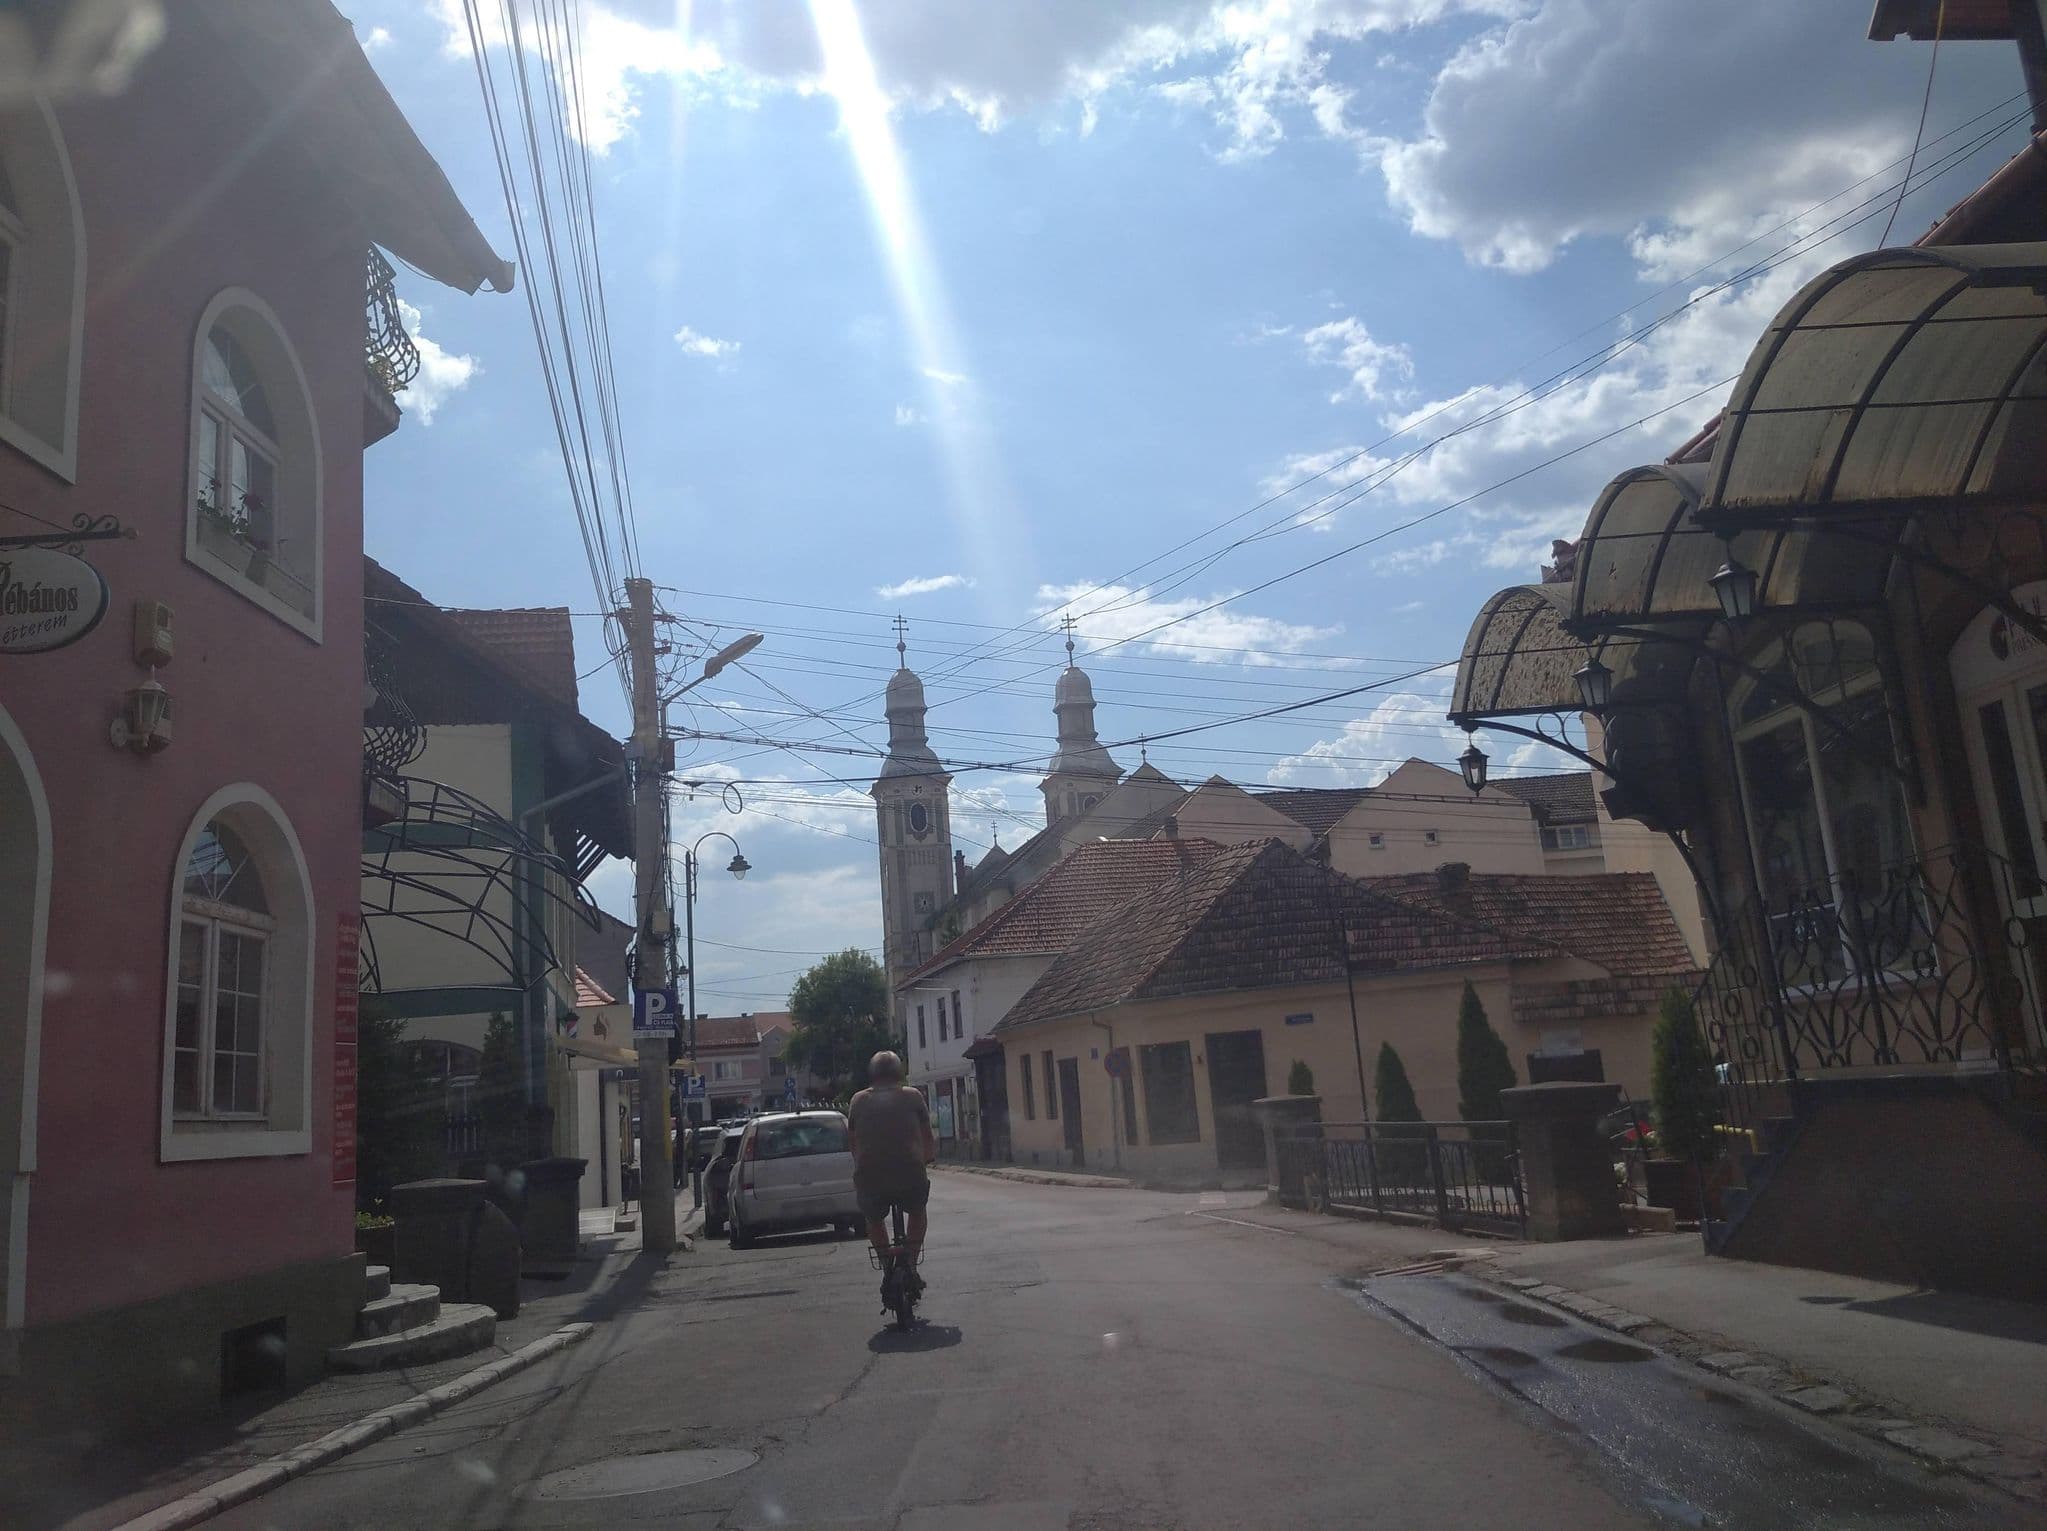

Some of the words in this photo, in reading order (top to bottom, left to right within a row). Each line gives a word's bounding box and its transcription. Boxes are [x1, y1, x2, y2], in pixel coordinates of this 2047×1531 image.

[3, 614, 68, 645] étterem
[646, 993, 667, 1026] P
[688, 1076, 701, 1095] P
